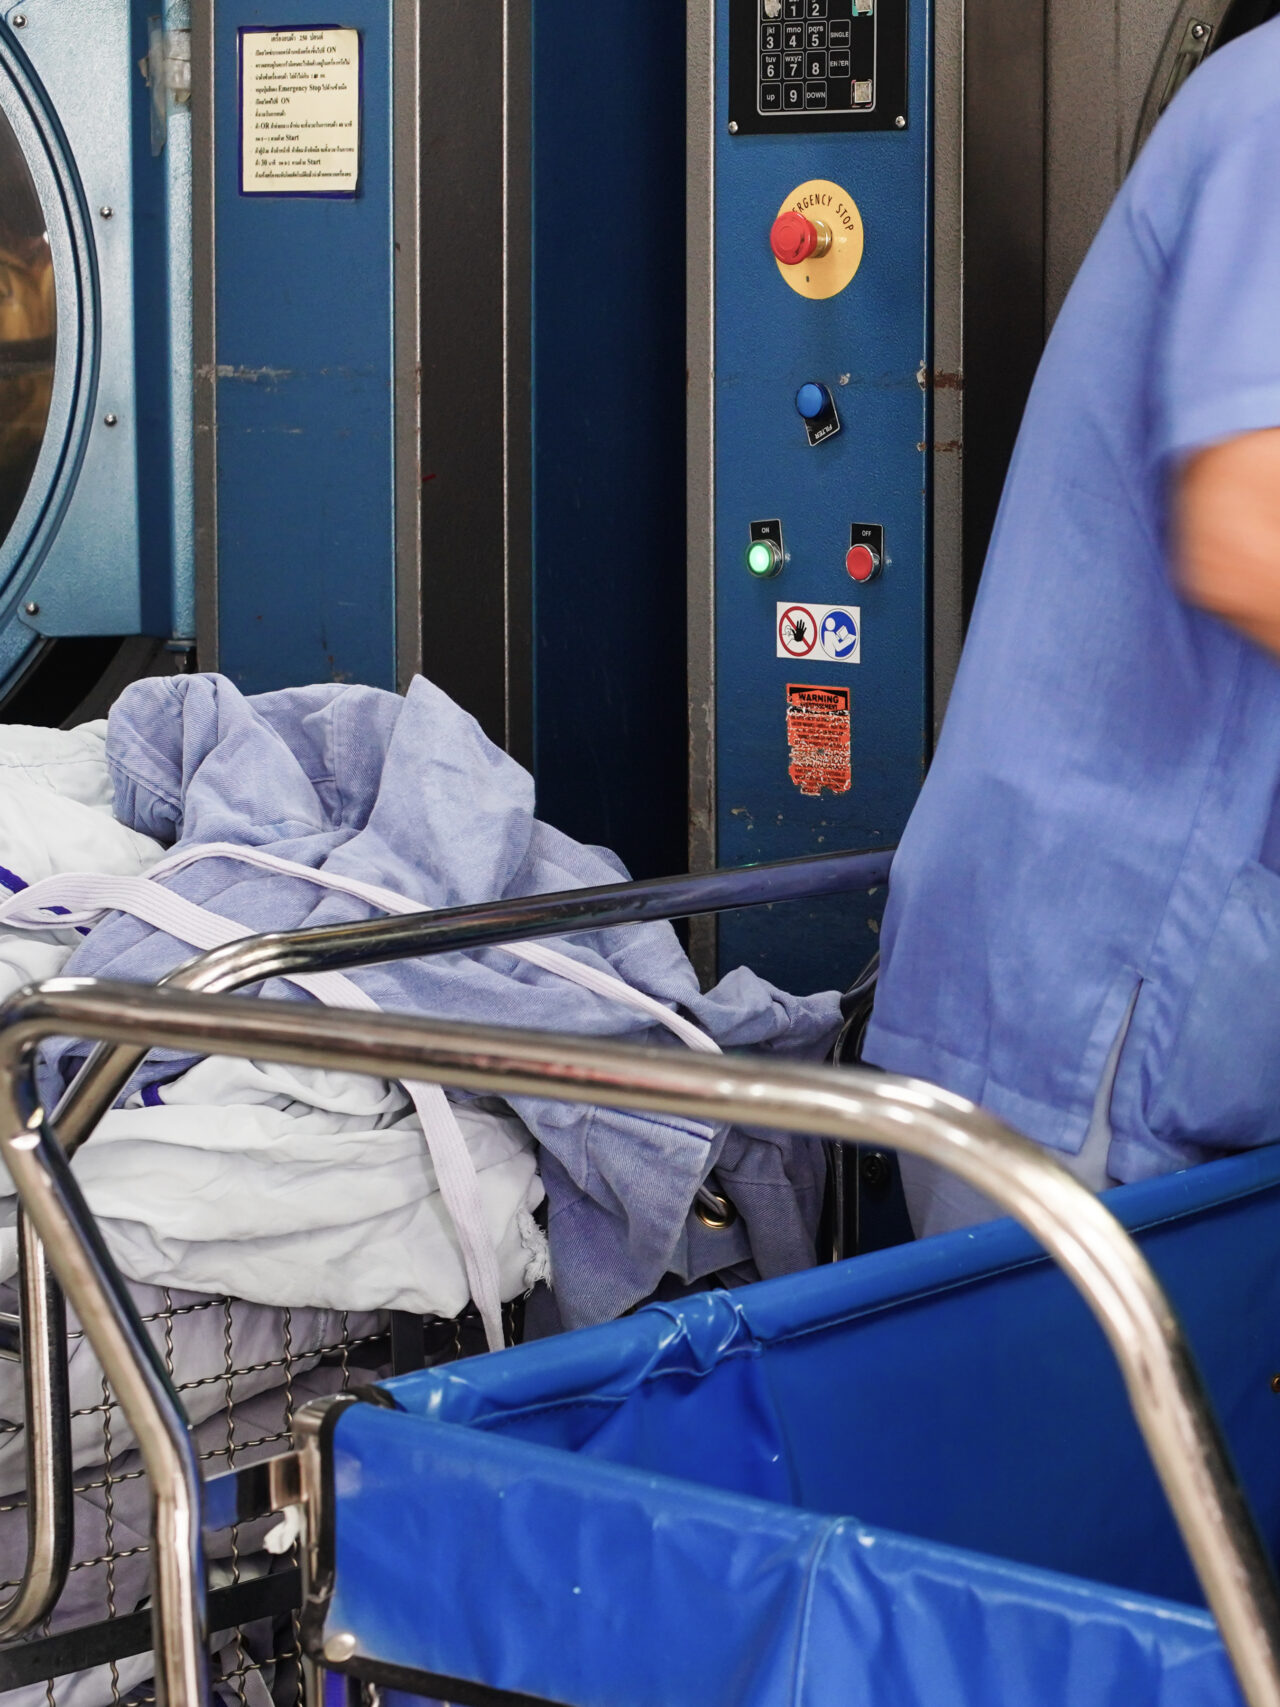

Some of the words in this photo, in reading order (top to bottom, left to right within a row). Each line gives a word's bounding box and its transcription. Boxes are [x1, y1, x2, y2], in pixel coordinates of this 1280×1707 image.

[790, 5, 796, 17] 1
[811, 3, 820, 16] 2
[808, 25, 824, 34] pqrs
[766, 36, 774, 49] 3
[789, 35, 797, 47] 4
[811, 34, 819, 47] 5
[785, 55, 802, 63] wxyz
[766, 64, 775, 77] 6
[789, 63, 798, 76] 7
[811, 62, 820, 75] 8
[278, 84, 308, 93] Emergency
[309, 84, 322, 93] Stop
[766, 94, 776, 102] up
[789, 89, 798, 102] 9
[792, 193, 833, 213] RGENCY
[835, 203, 855, 231] STOP
[798, 692, 839, 704] WARNING
